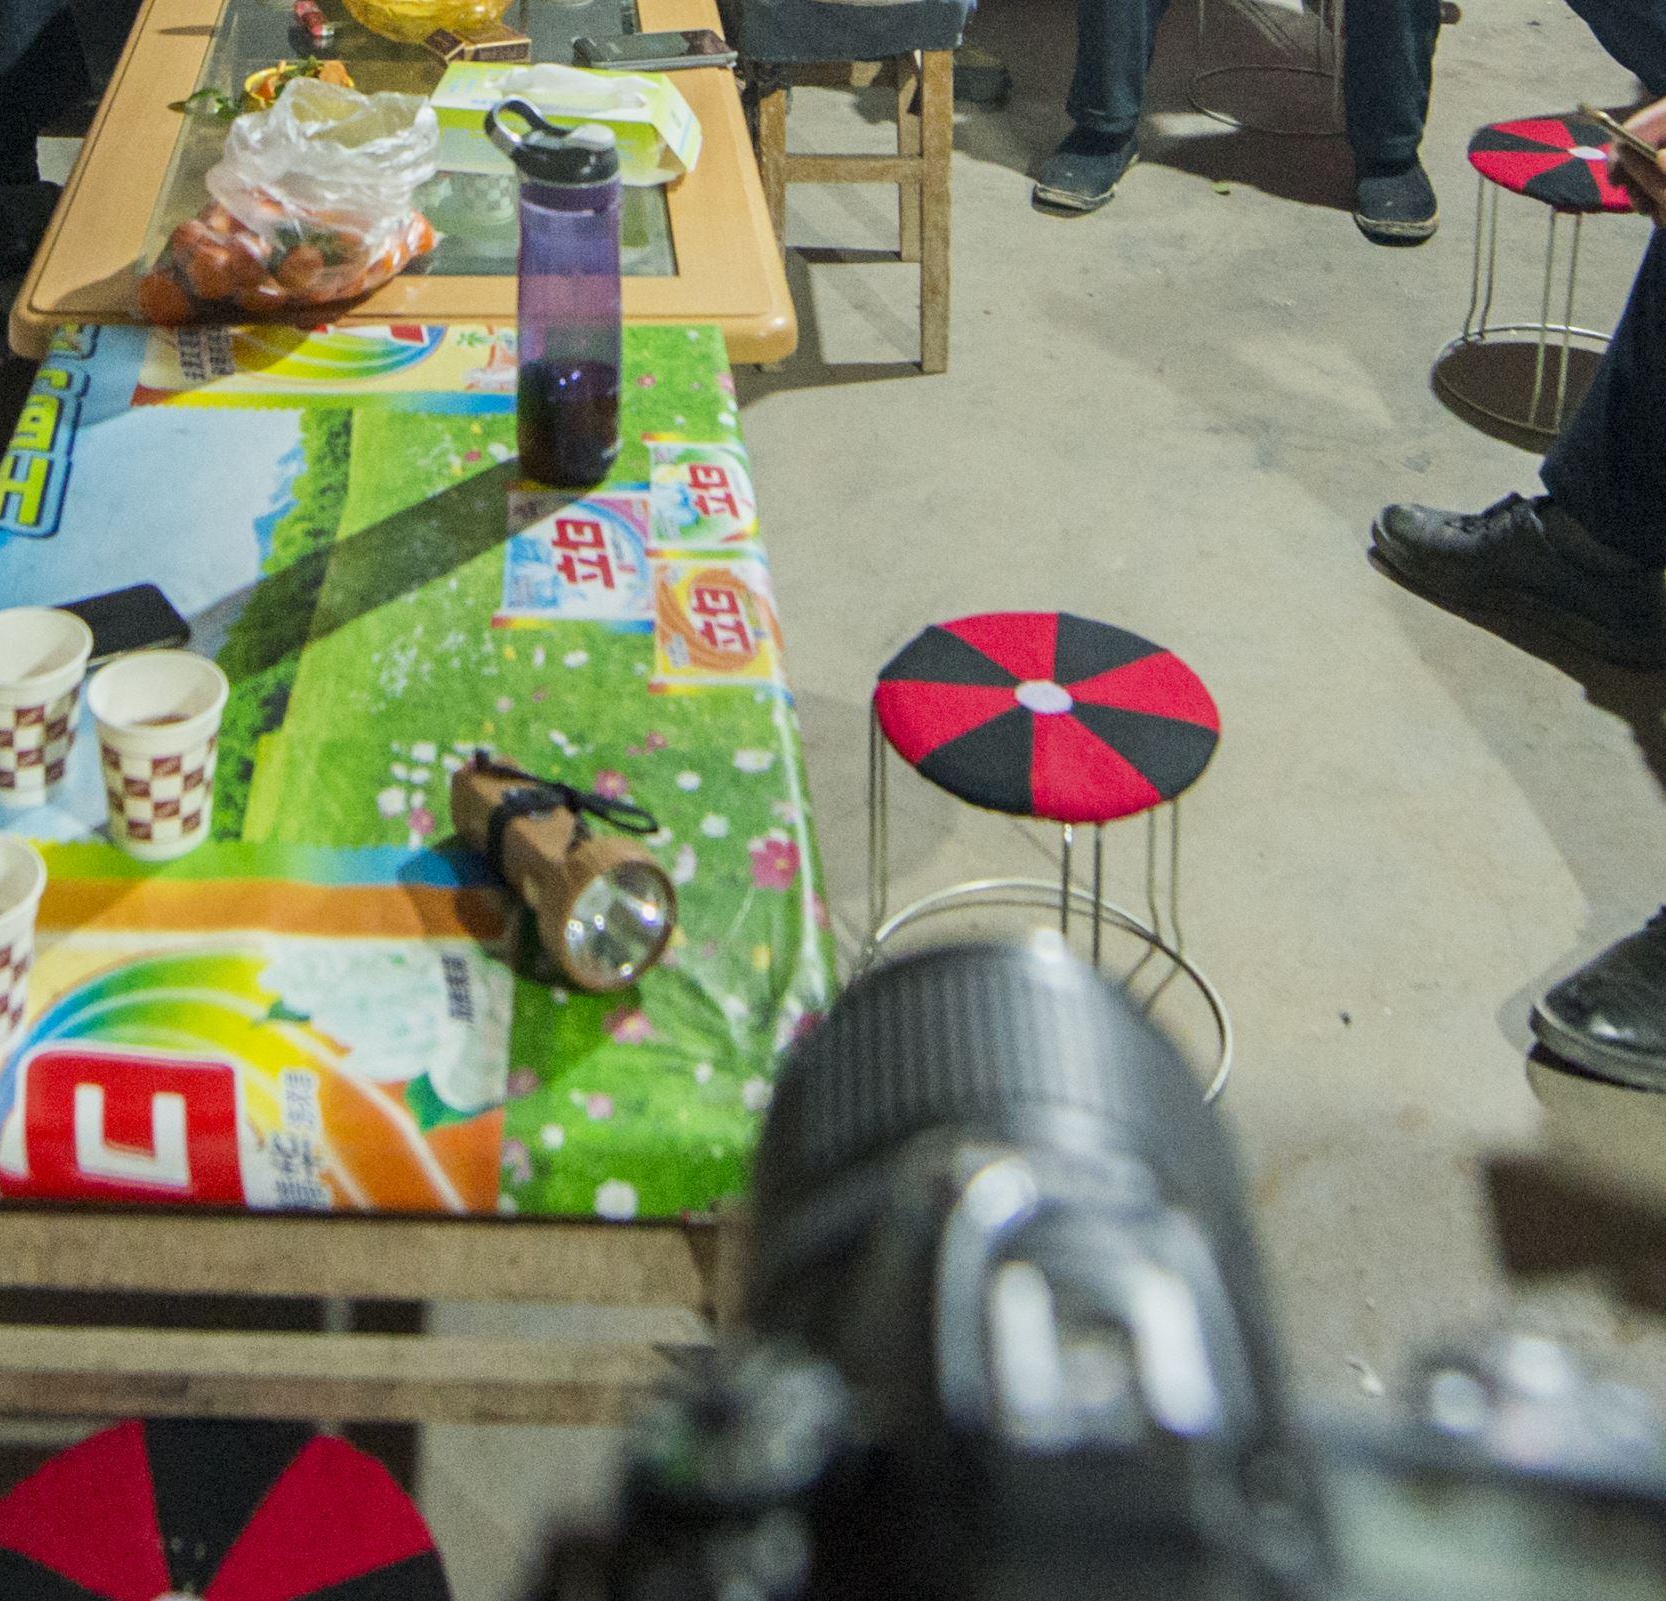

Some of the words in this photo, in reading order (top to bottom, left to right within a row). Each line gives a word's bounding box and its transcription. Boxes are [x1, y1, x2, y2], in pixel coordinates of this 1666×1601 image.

[687, 463, 740, 519] 立白
[551, 518, 615, 589] 立白
[691, 587, 752, 652] 立白
